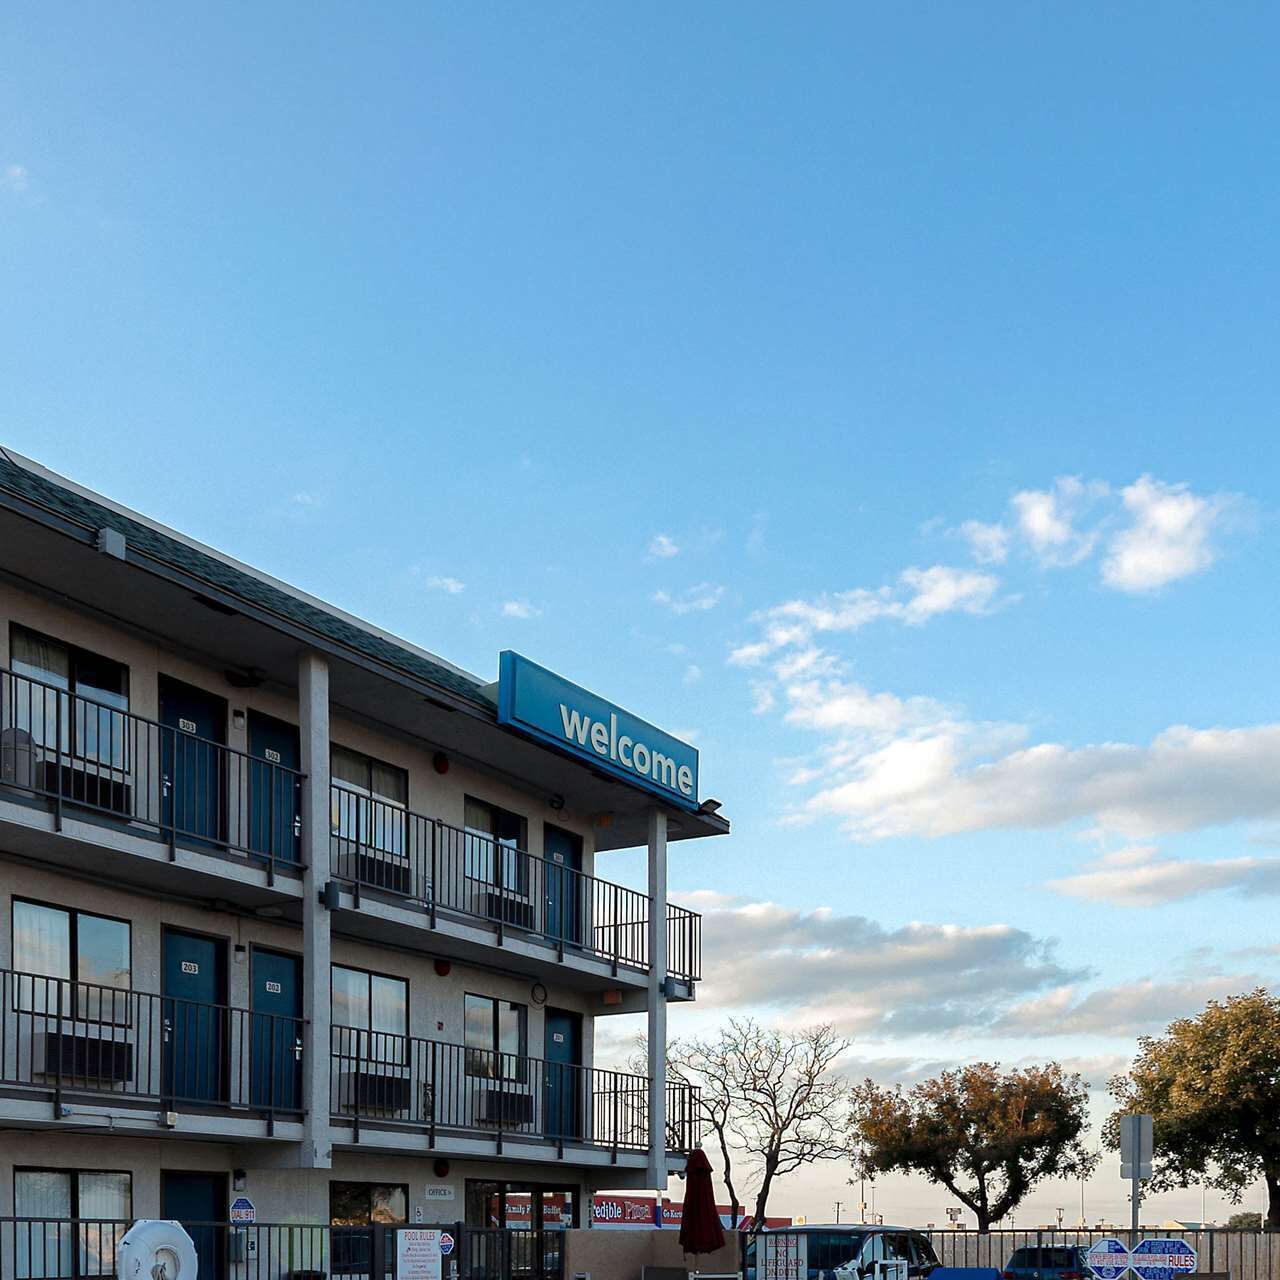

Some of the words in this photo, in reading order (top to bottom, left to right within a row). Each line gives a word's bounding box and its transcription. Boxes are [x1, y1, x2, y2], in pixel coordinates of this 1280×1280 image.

[559, 703, 694, 795] welcome
[184, 963, 197, 973] 203
[404, 1232, 418, 1240] POOL
[420, 1232, 435, 1240] RULES
[1169, 1255, 1195, 1267] RULES
